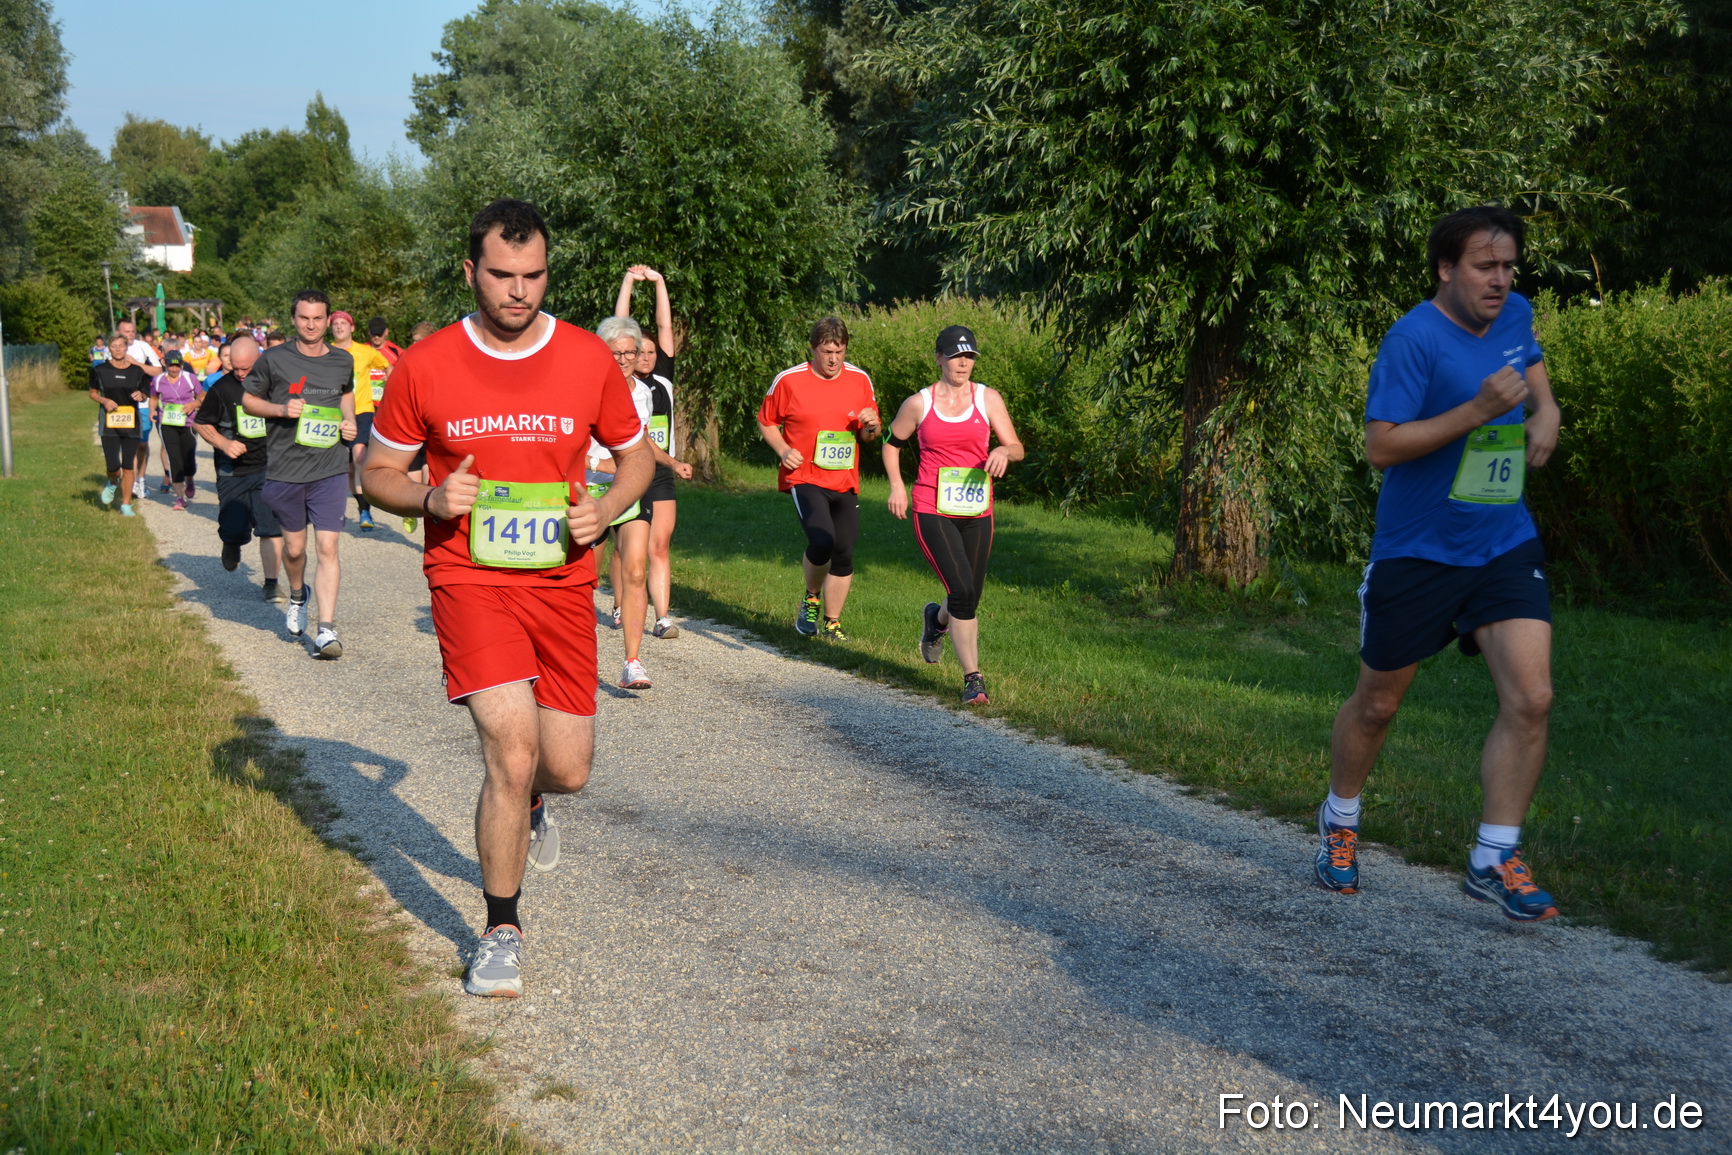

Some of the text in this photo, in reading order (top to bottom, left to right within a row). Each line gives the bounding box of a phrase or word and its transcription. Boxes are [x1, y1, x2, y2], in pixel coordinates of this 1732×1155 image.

[303, 387, 340, 396] duerrer.de
[110, 414, 132, 422] 1228
[447, 414, 557, 437] NEUMARKT
[304, 421, 338, 438] 1422
[821, 446, 852, 459] 1369
[1487, 457, 1512, 483] 16
[944, 486, 985, 503] 1368
[482, 515, 560, 545] 1410
